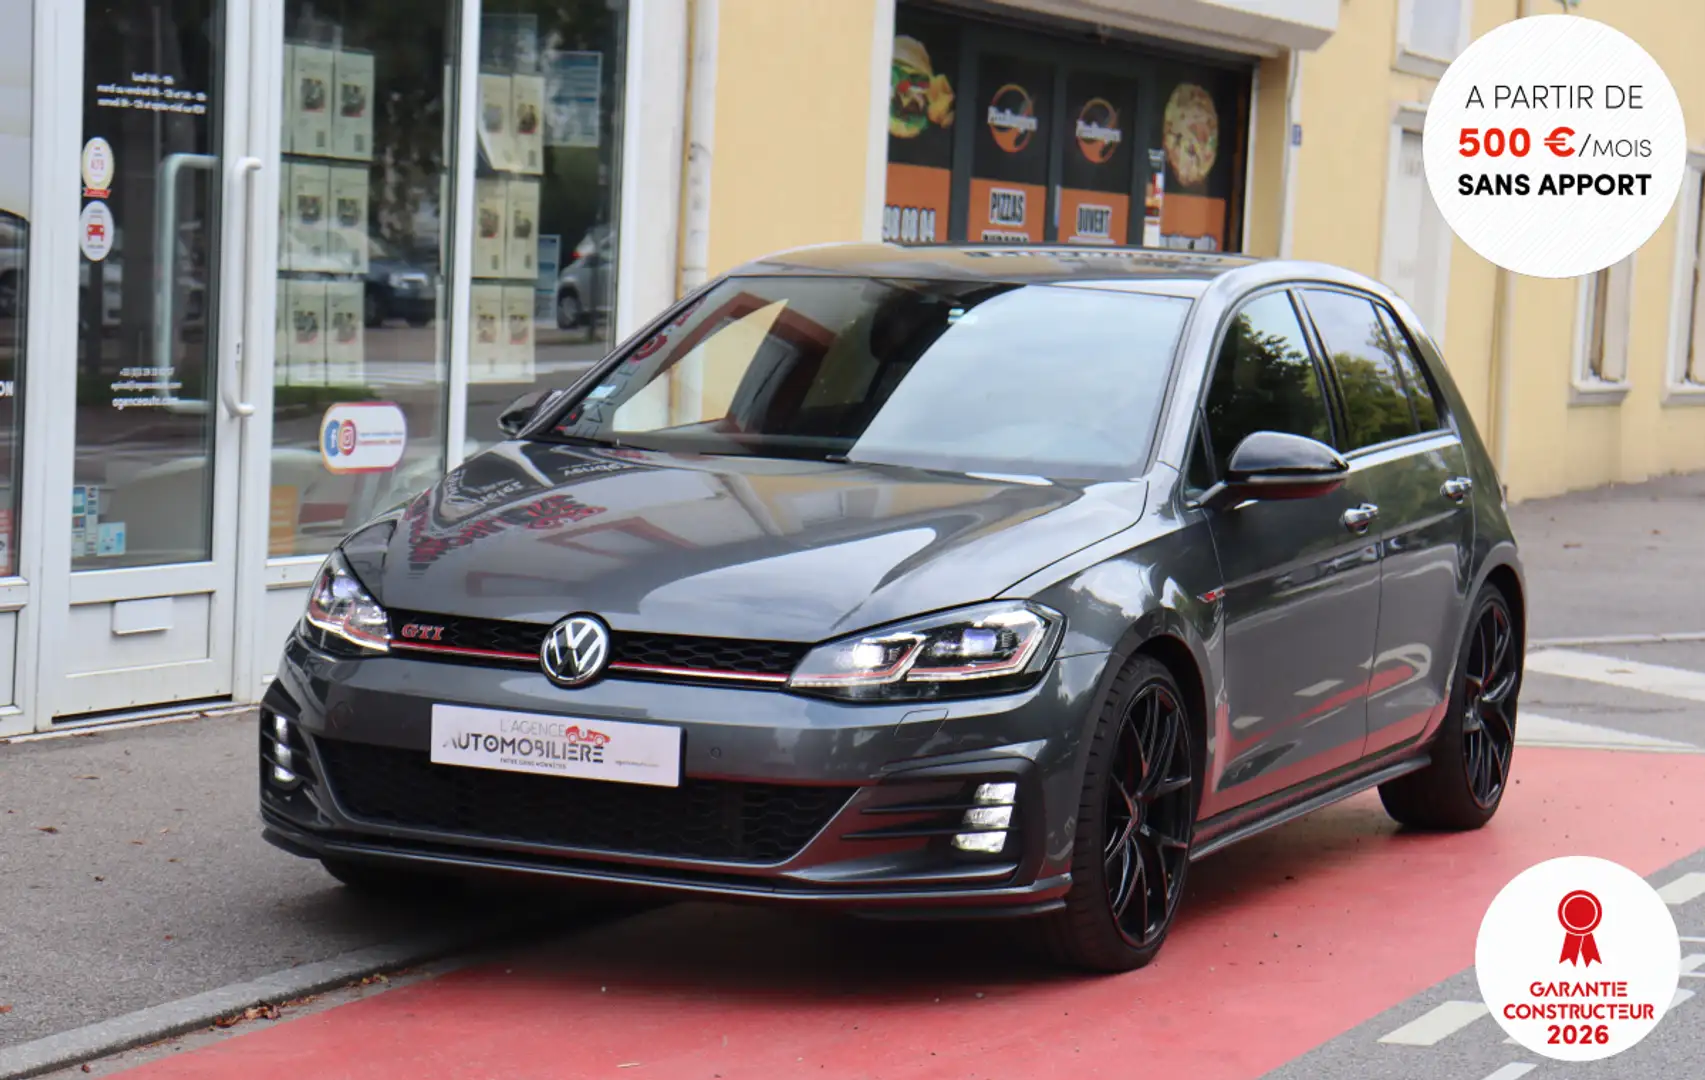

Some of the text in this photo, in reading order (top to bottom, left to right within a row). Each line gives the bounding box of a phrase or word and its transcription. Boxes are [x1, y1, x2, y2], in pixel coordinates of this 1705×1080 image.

[990, 190, 1023, 222] PIZZAS
[1078, 206, 1110, 234] OUVERT
[401, 623, 445, 640] GTI
[500, 718, 566, 738] L'AGENCE
